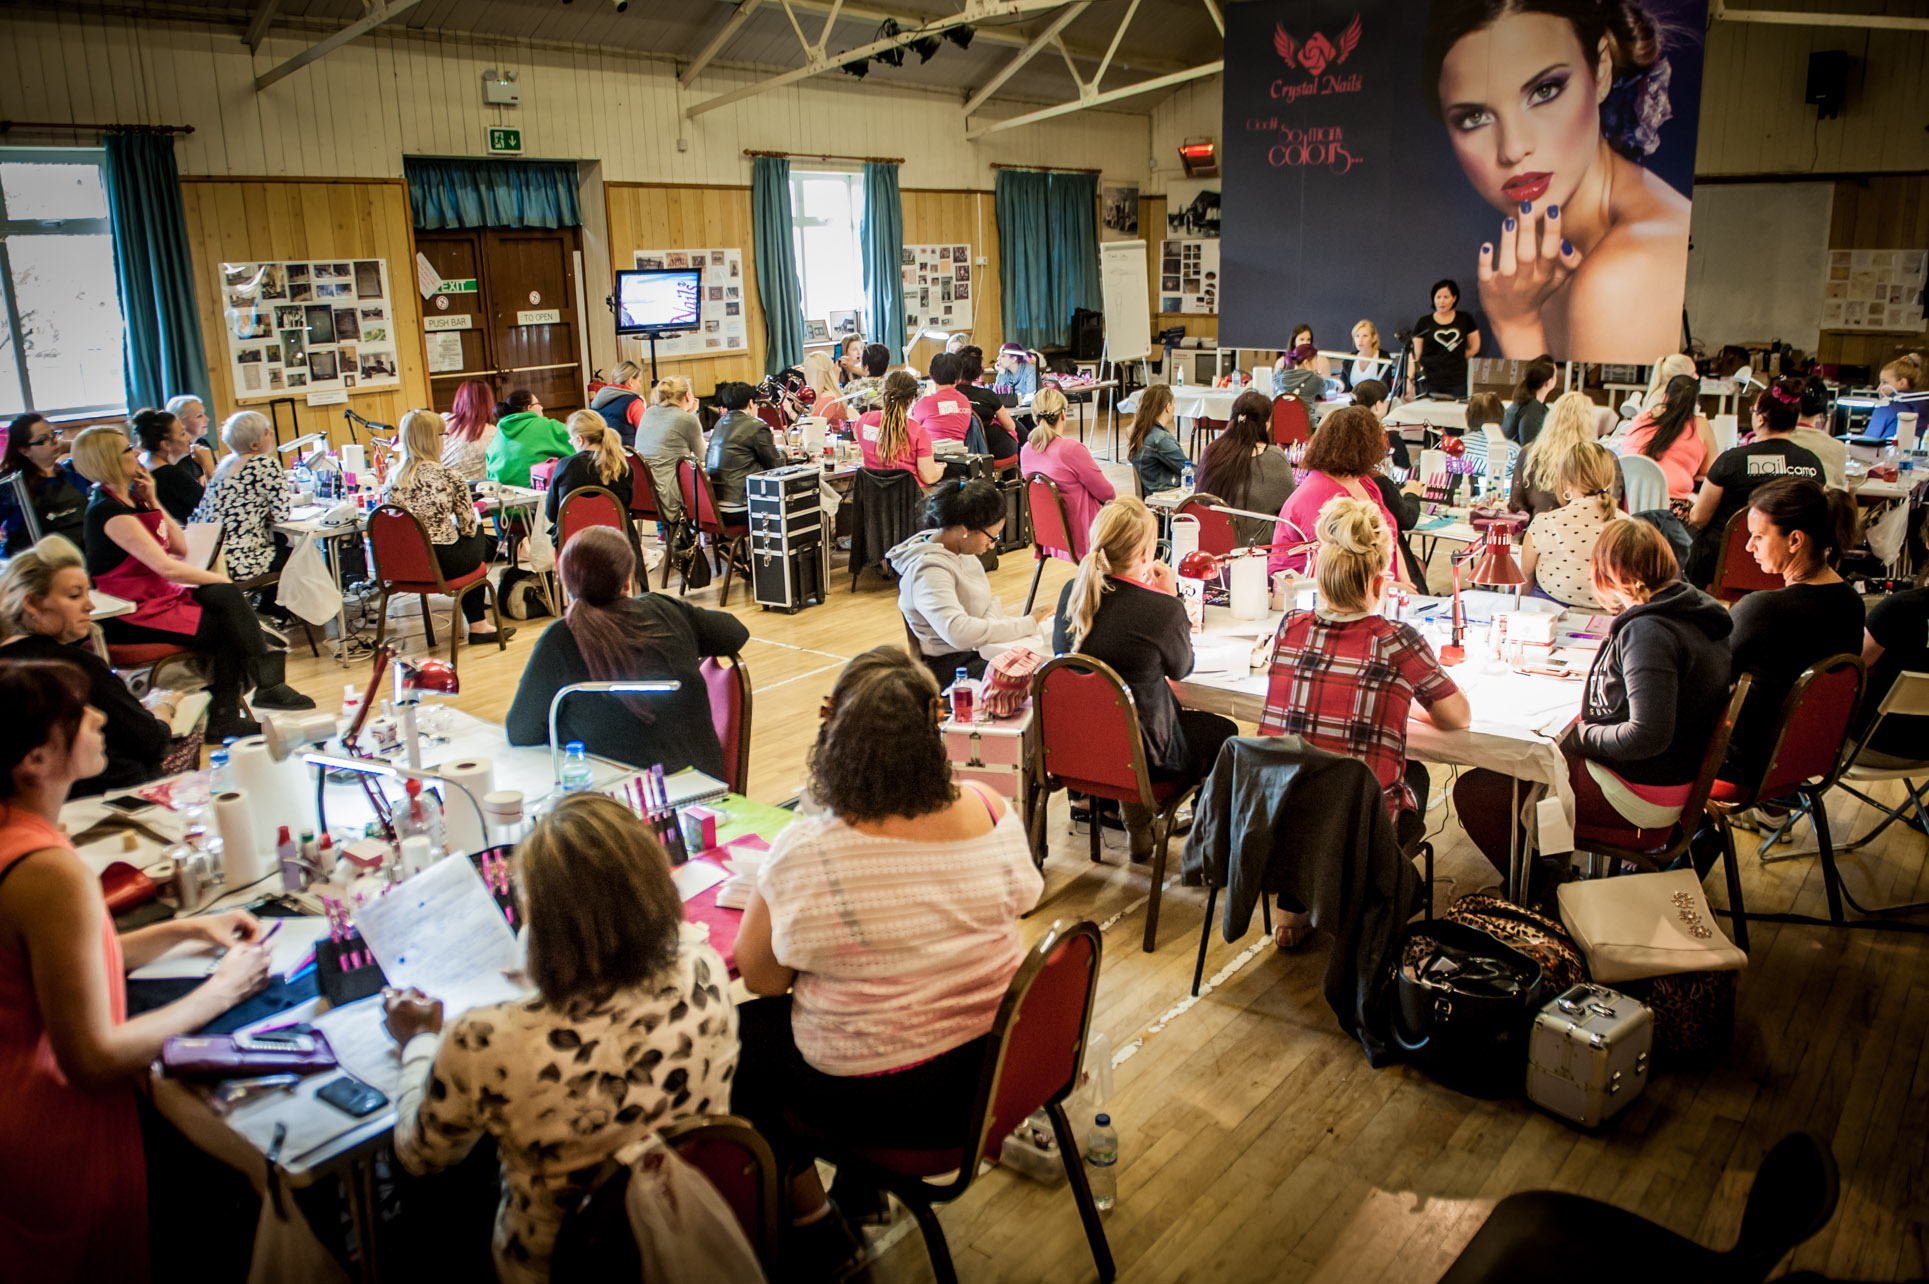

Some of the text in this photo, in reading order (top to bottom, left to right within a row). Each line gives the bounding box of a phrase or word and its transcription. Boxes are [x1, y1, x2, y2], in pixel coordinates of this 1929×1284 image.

[1270, 74, 1362, 103] Crystal Nails
[441, 280, 467, 292] EXIT
[429, 317, 466, 328] PUSH BAR
[524, 313, 553, 322] TO OPEN
